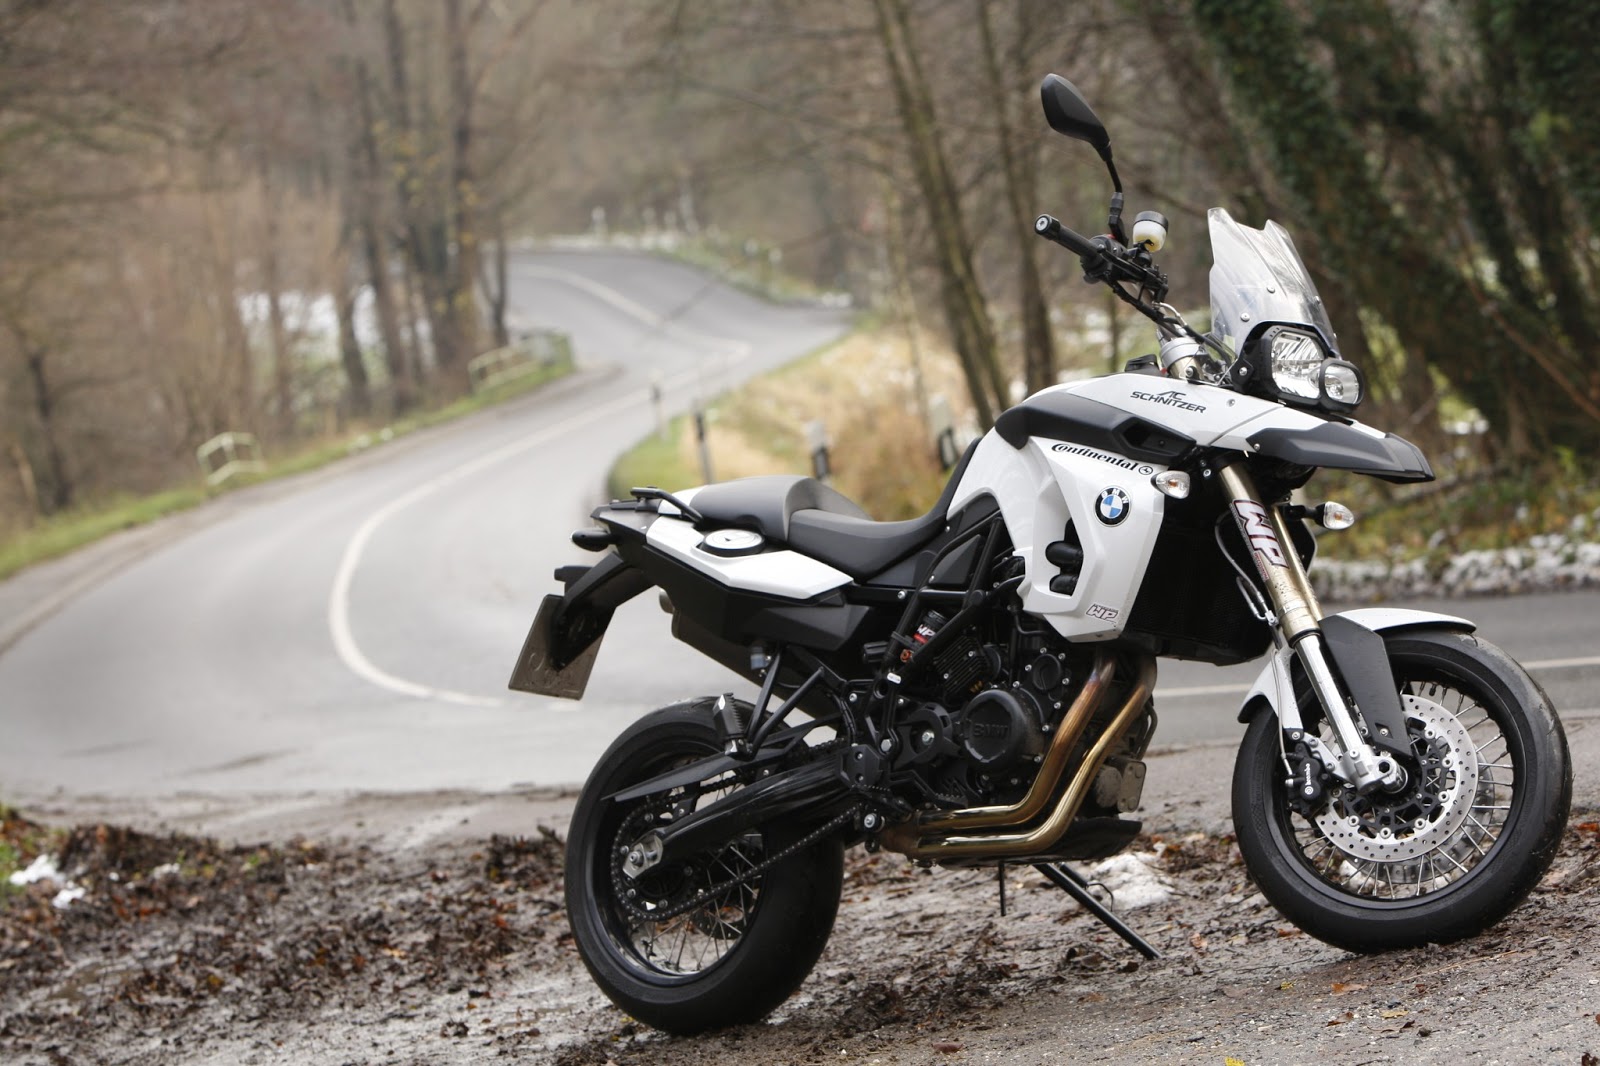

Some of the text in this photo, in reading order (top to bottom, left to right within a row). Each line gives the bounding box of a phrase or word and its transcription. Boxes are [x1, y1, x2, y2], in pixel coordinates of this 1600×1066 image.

[1130, 391, 1207, 414] SCHNITZER
[1159, 390, 1187, 401] AC
[1051, 443, 1139, 471] Continental
[1233, 499, 1290, 569] WP
[1086, 603, 1119, 621] WP
[973, 723, 1009, 737] BMW
